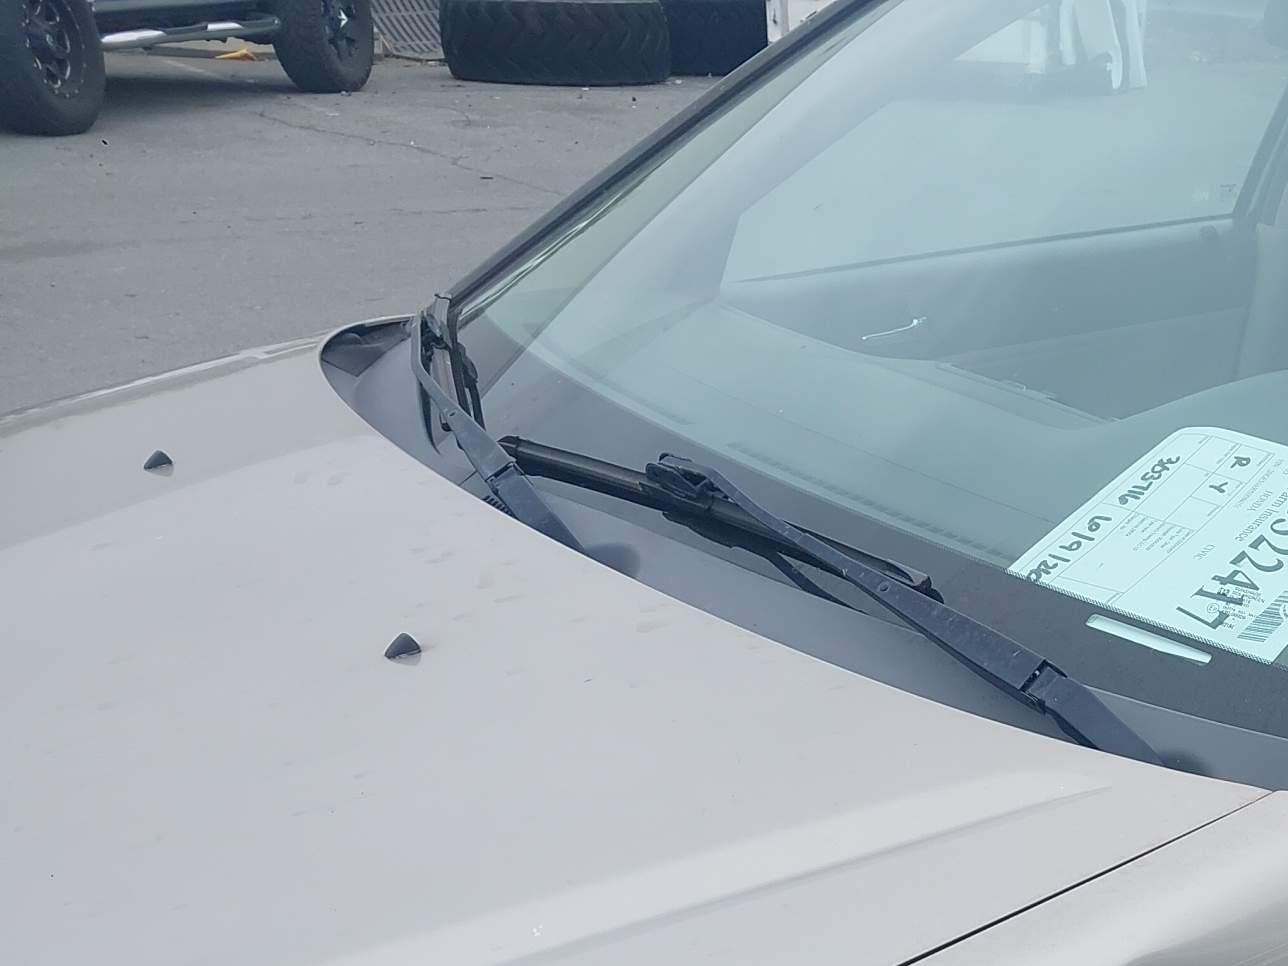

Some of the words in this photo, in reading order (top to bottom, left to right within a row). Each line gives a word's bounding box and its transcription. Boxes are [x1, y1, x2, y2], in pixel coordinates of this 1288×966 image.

[1229, 455, 1252, 470] R
[1208, 480, 1229, 494] Y
[1246, 489, 1273, 512] HONDA
[1234, 506, 1282, 542] Insurance
[1193, 543, 1217, 561] CIVIC
